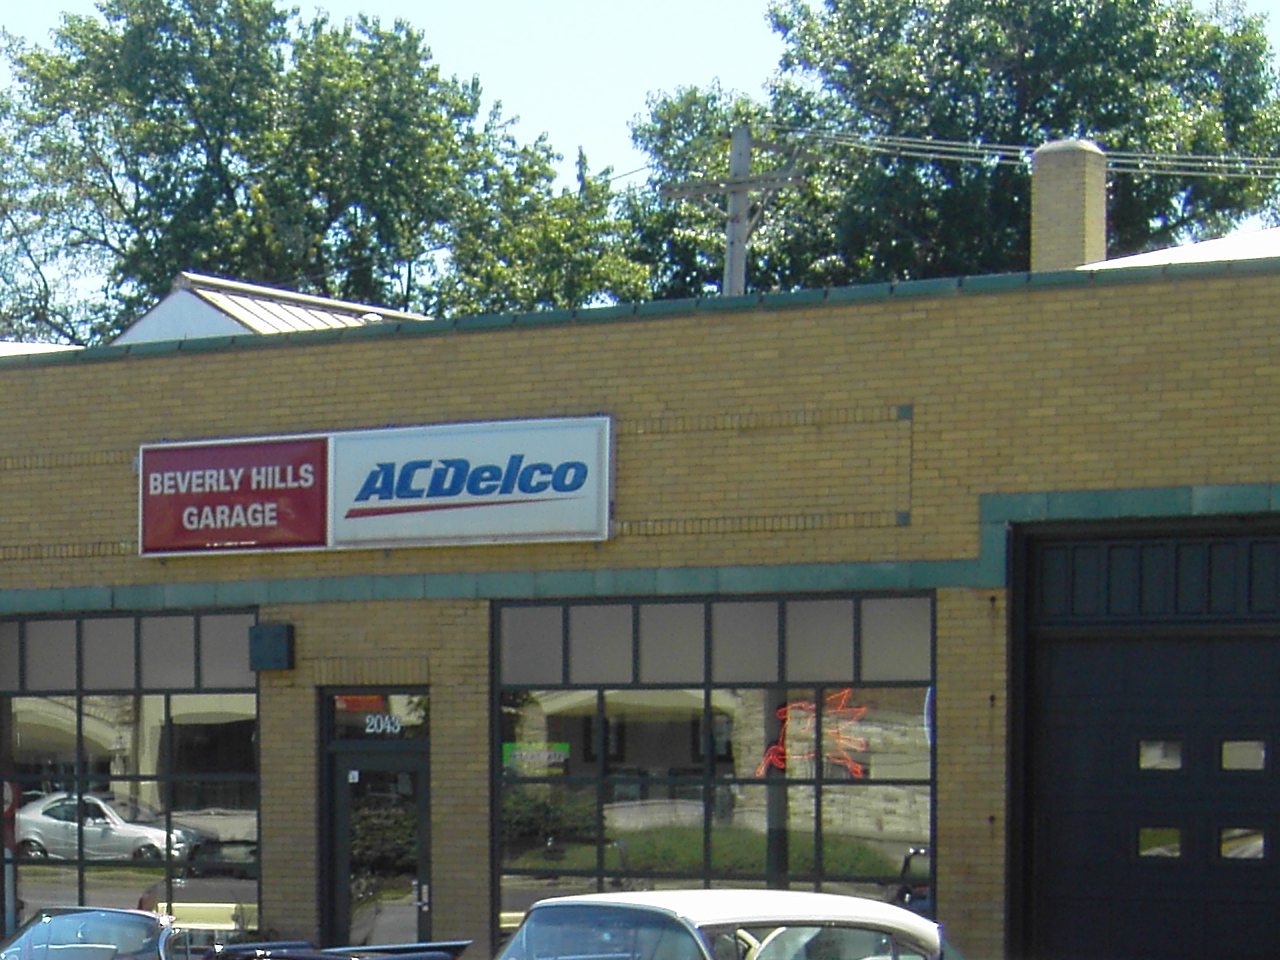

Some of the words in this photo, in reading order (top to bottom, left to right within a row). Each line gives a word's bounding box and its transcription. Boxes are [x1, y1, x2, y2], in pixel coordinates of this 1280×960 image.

[149, 467, 244, 496] BEVERLY
[250, 463, 315, 490] HILLS
[354, 454, 588, 502] ACDelco
[182, 503, 278, 530] GARAGE
[365, 714, 401, 733] 2043
